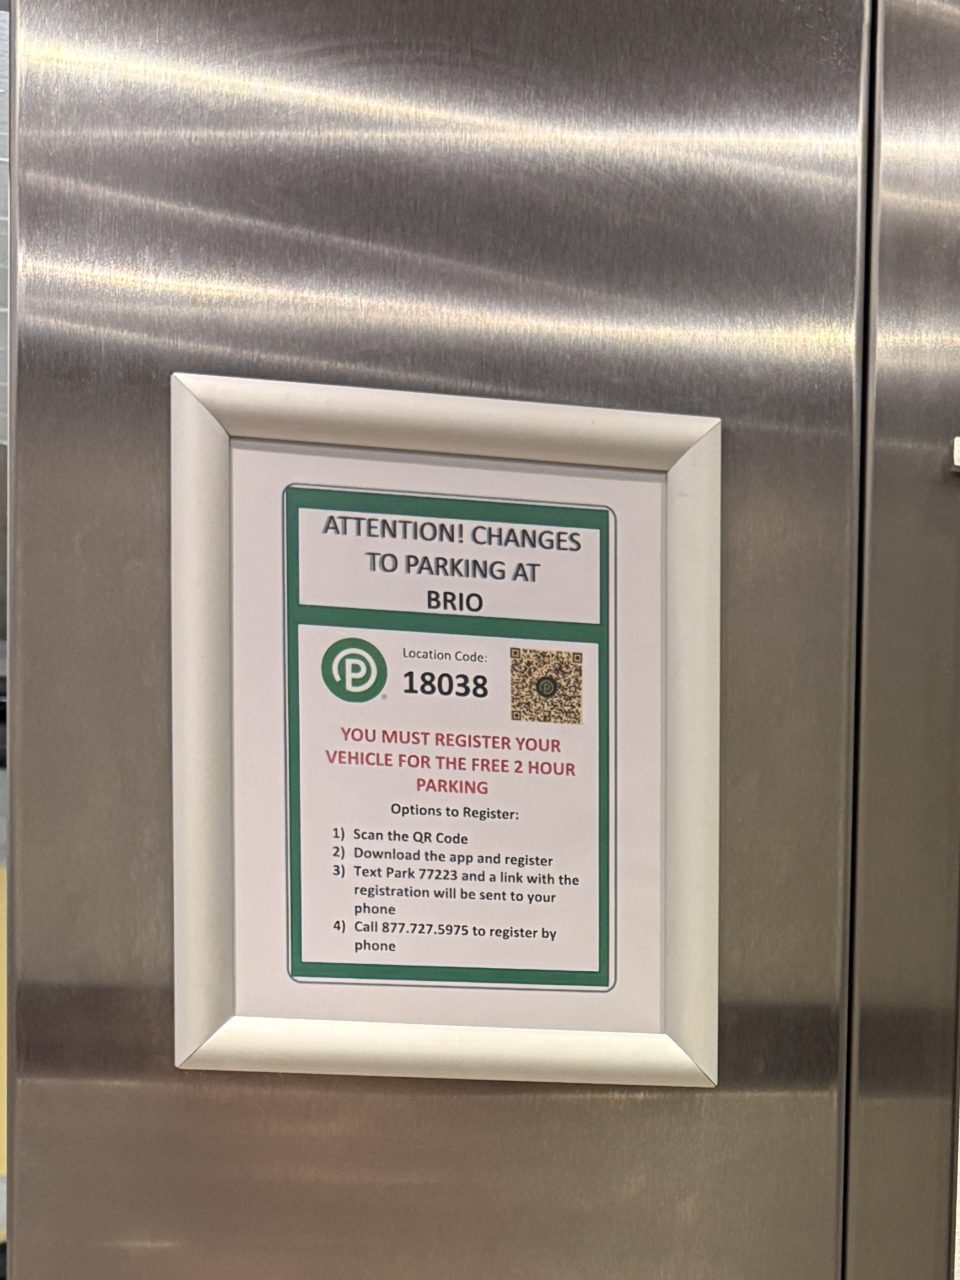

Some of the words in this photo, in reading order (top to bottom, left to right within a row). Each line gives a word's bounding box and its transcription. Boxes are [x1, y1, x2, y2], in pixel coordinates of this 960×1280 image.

[322, 515, 464, 543] ATTENTION!
[471, 525, 581, 552] CHANGES
[365, 552, 398, 573] TO
[405, 554, 506, 581] PARKING
[512, 563, 541, 582] AT
[427, 590, 483, 613] BRIO
[402, 647, 451, 662] Location
[454, 649, 488, 663] Code:
[403, 670, 489, 698] 18038
[340, 727, 377, 744] YOU
[382, 729, 431, 746] MUST
[435, 732, 511, 750] REGISTER
[515, 737, 561, 753] YOUR
[326, 750, 394, 768] VEHICLE
[399, 754, 431, 770] FOR
[435, 756, 467, 772] THE
[472, 758, 510, 774] FREE
[514, 760, 524, 775] 2
[528, 760, 576, 777] HOUR
[416, 778, 489, 795] PARKING
[391, 803, 442, 820] Options
[446, 806, 459, 818] to
[463, 806, 519, 822] Register:
[333, 827, 345, 843] 1)
[353, 828, 383, 843] Scan
[387, 829, 409, 844] the
[412, 831, 433, 846] QR
[436, 831, 469, 845] Code
[333, 845, 346, 861] 2)
[354, 847, 420, 862] Download
[424, 850, 446, 864] the
[449, 853, 474, 868] app
[478, 851, 501, 865] and
[505, 853, 554, 870] register
[333, 864, 346, 880] 3)
[354, 865, 382, 880] Text
[386, 866, 416, 881] Park
[419, 867, 458, 882] 77223
[462, 869, 485, 883] and
[489, 873, 497, 884] a
[501, 871, 523, 885] link
[527, 872, 555, 886] with
[558, 873, 580, 887] the
[354, 884, 430, 901] registration
[433, 886, 457, 900] will
[460, 887, 476, 901] be
[480, 889, 508, 902] sent
[510, 890, 524, 903] to
[527, 892, 557, 906] your
[354, 902, 396, 917] phone
[333, 919, 346, 935] 4)
[354, 920, 379, 933] Call
[381, 921, 469, 937] 877.727.5975
[472, 924, 486, 938] to
[489, 925, 538, 941] register
[541, 927, 557, 942] by
[354, 939, 397, 953] phone
